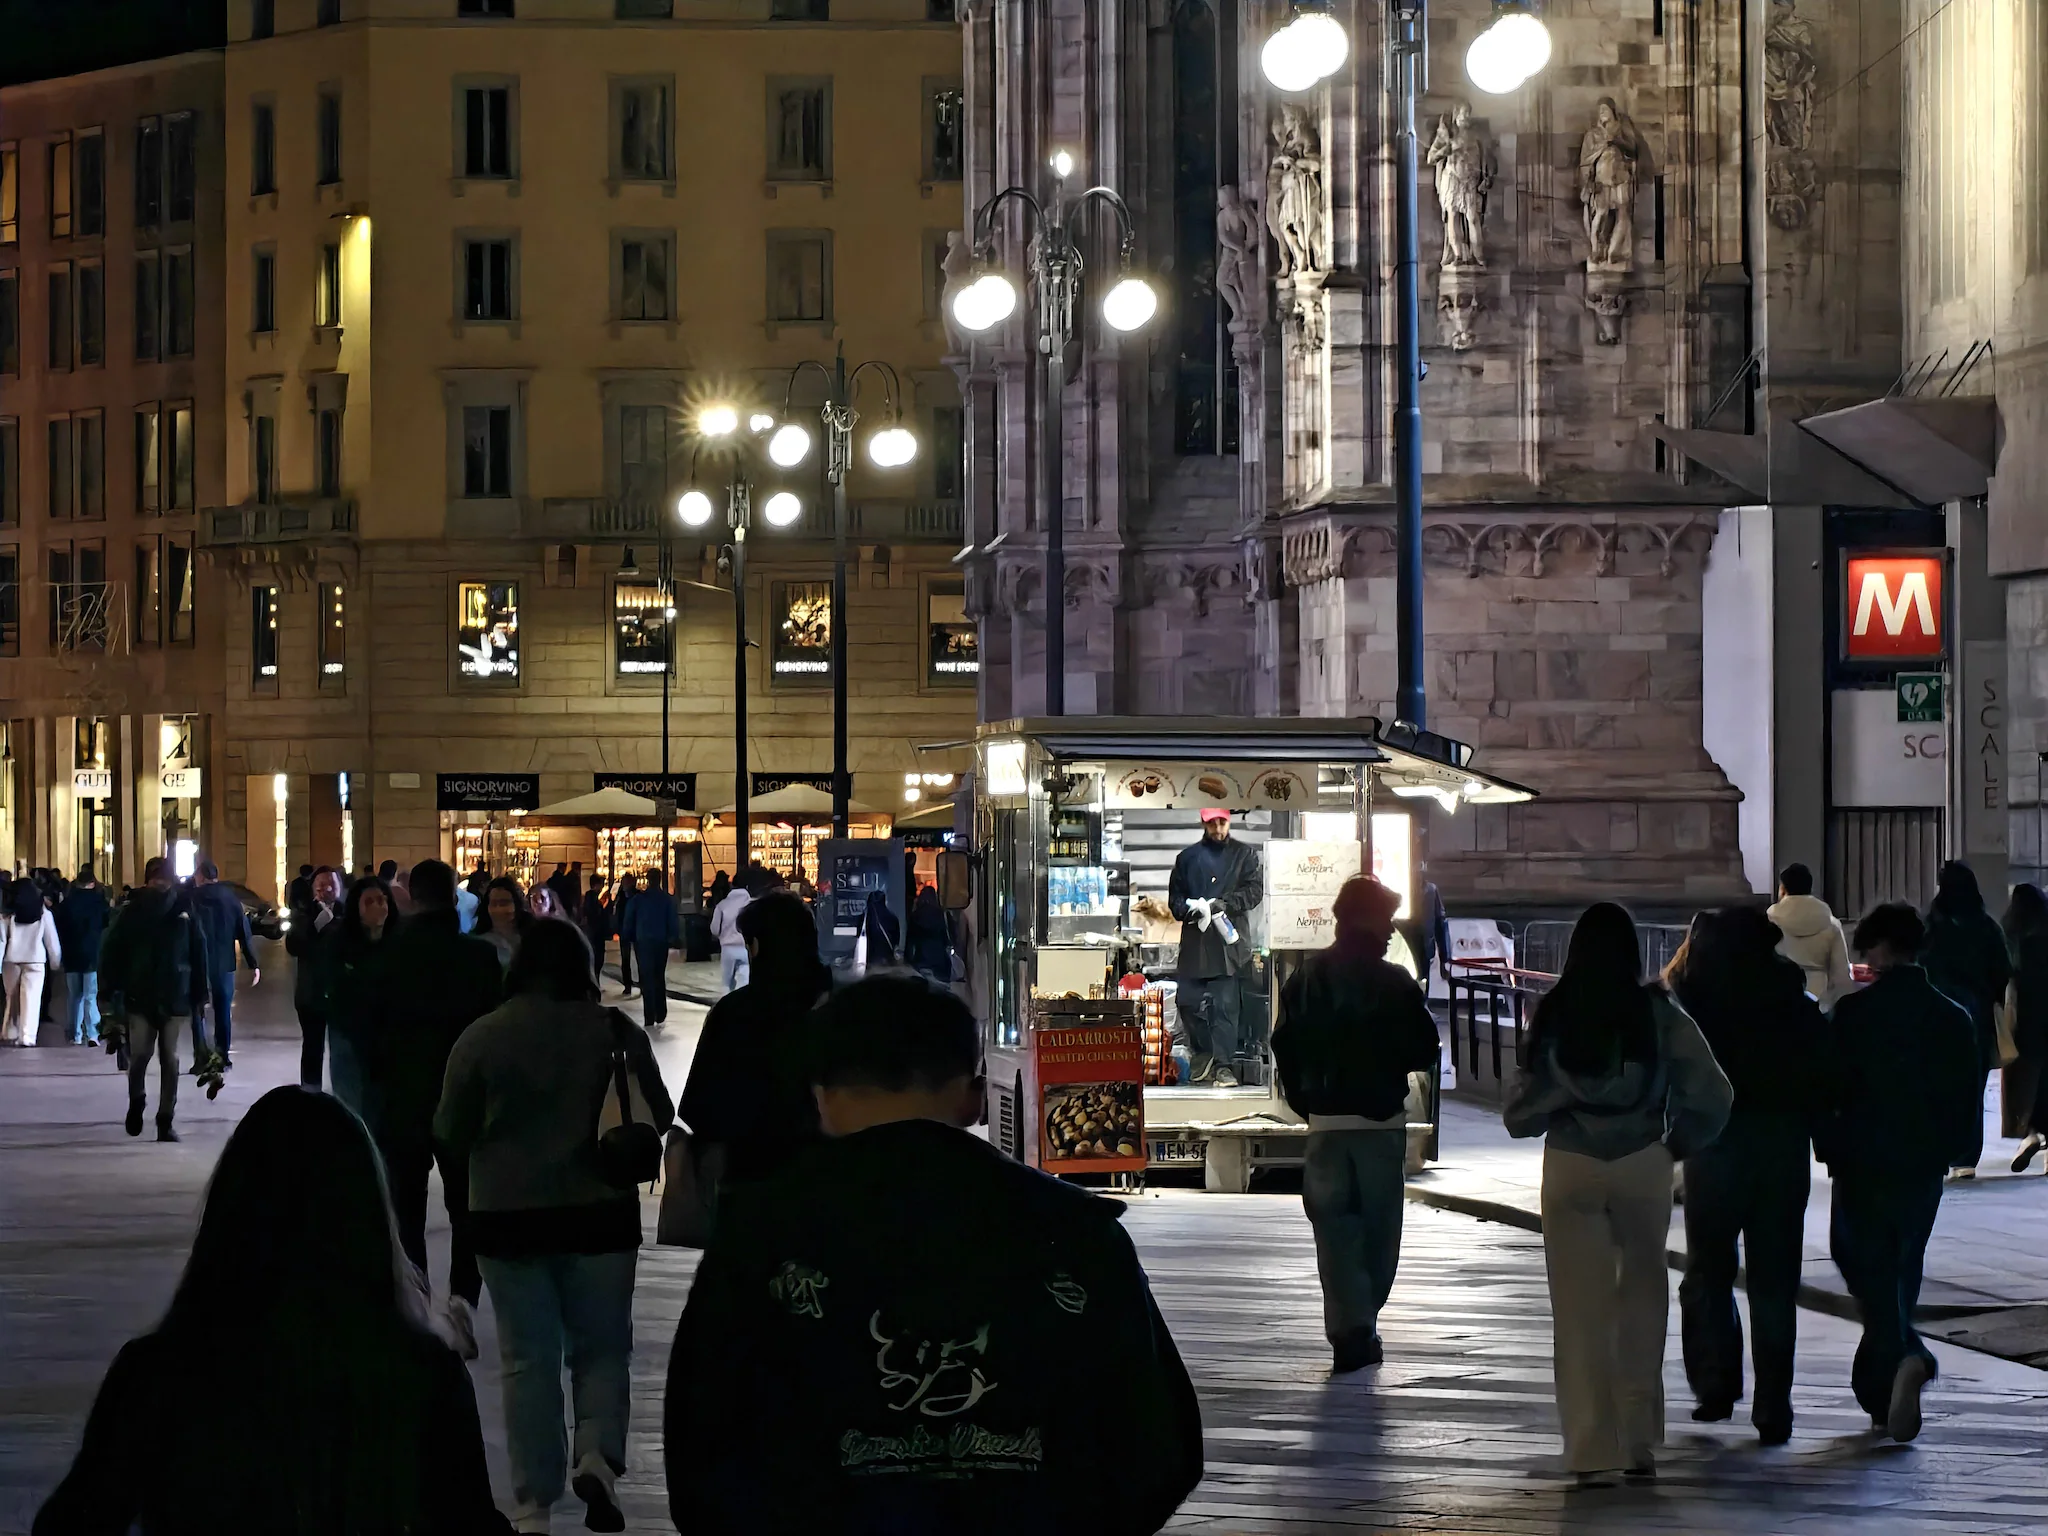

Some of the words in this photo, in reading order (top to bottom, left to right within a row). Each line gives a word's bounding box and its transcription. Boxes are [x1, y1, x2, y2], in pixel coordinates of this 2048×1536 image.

[1853, 572, 1936, 636] M
[461, 661, 514, 672] SIGVINO
[1904, 735, 1945, 759] SC
[1981, 679, 2001, 809] SCALE
[444, 780, 531, 793] SIGNORVINO
[601, 780, 688, 793] SIGNORVNO
